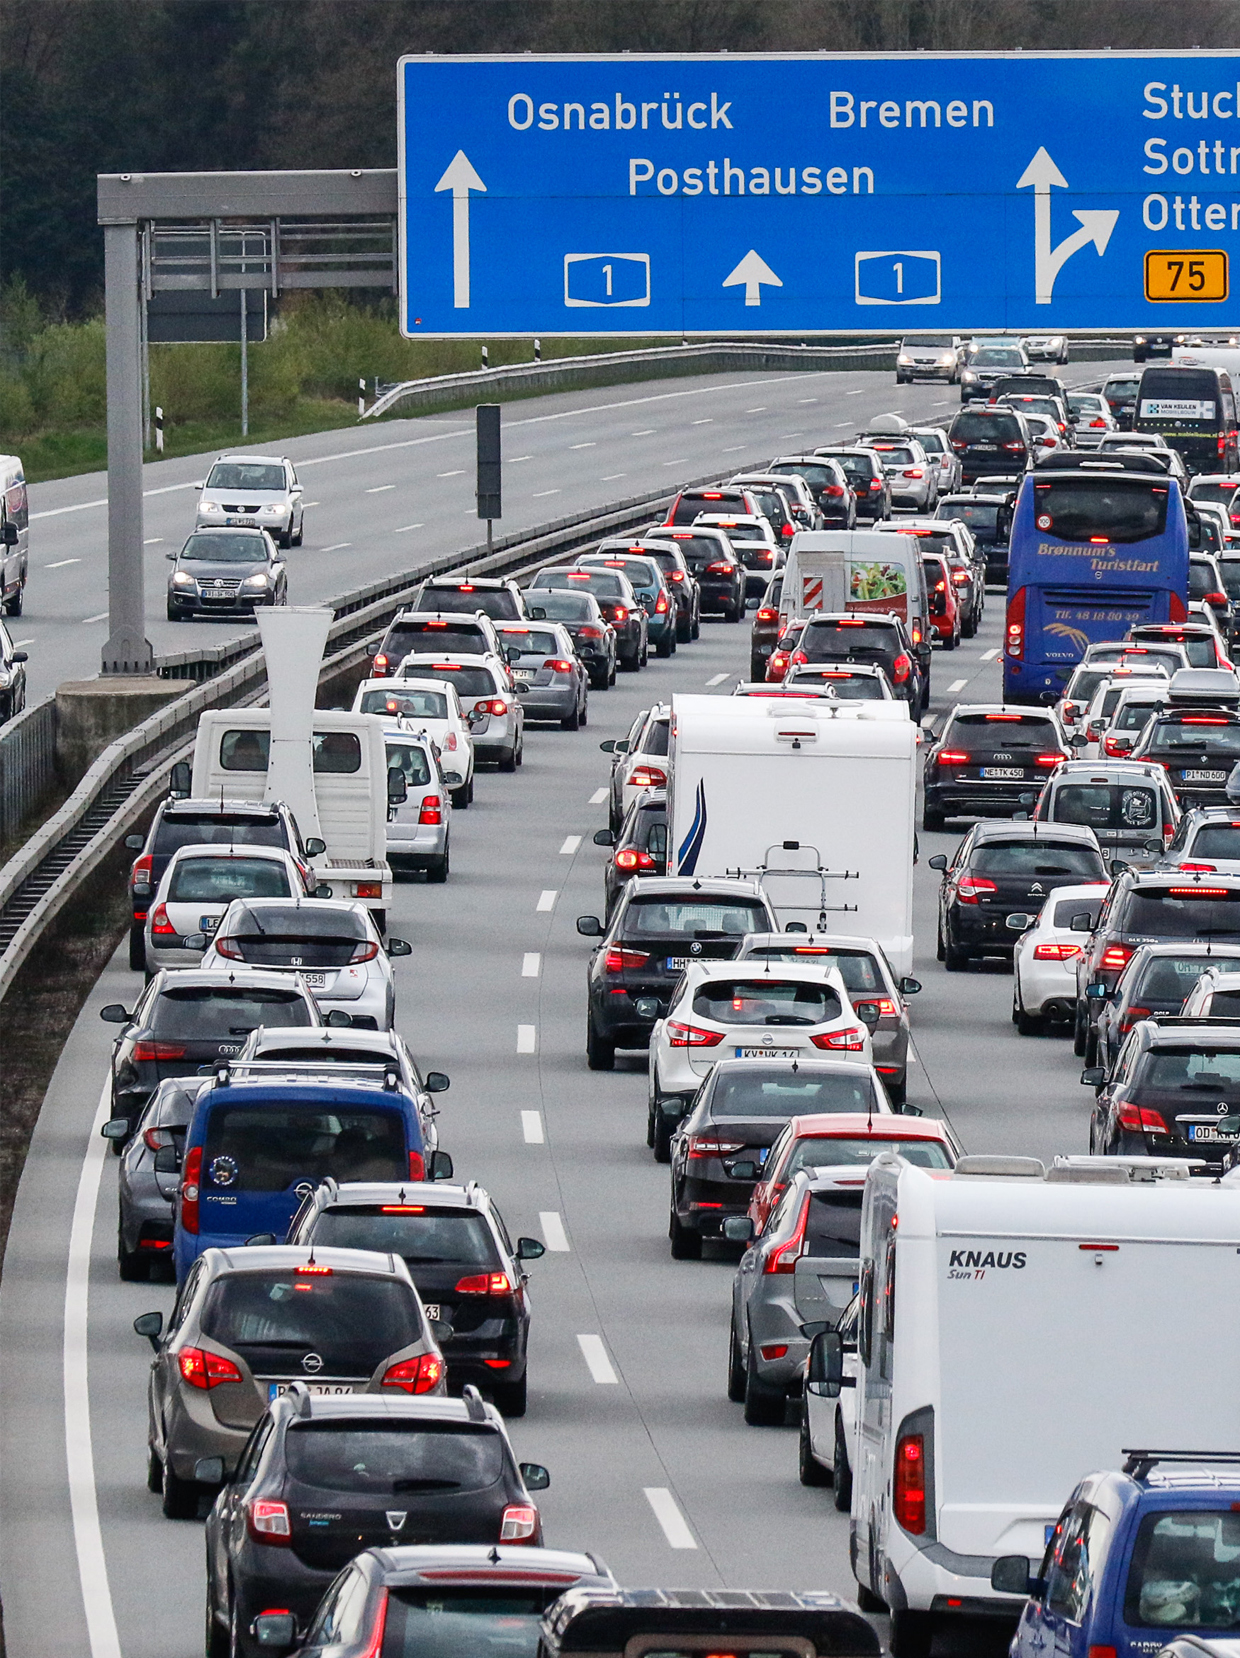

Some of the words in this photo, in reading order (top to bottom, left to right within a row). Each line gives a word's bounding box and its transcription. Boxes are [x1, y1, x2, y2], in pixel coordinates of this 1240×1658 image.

[507, 91, 734, 131] Osnabrück
[829, 91, 994, 129] Bremen
[629, 157, 875, 195] Posthausen
[602, 264, 613, 296] 1
[892, 262, 903, 294] 1
[1167, 260, 1206, 292] 75
[1090, 559, 1159, 572] Turistfart
[947, 1269, 972, 1280] Sun
[948, 1250, 1028, 1269] KNAUS
[300, 1512, 342, 1520] SANDERO
